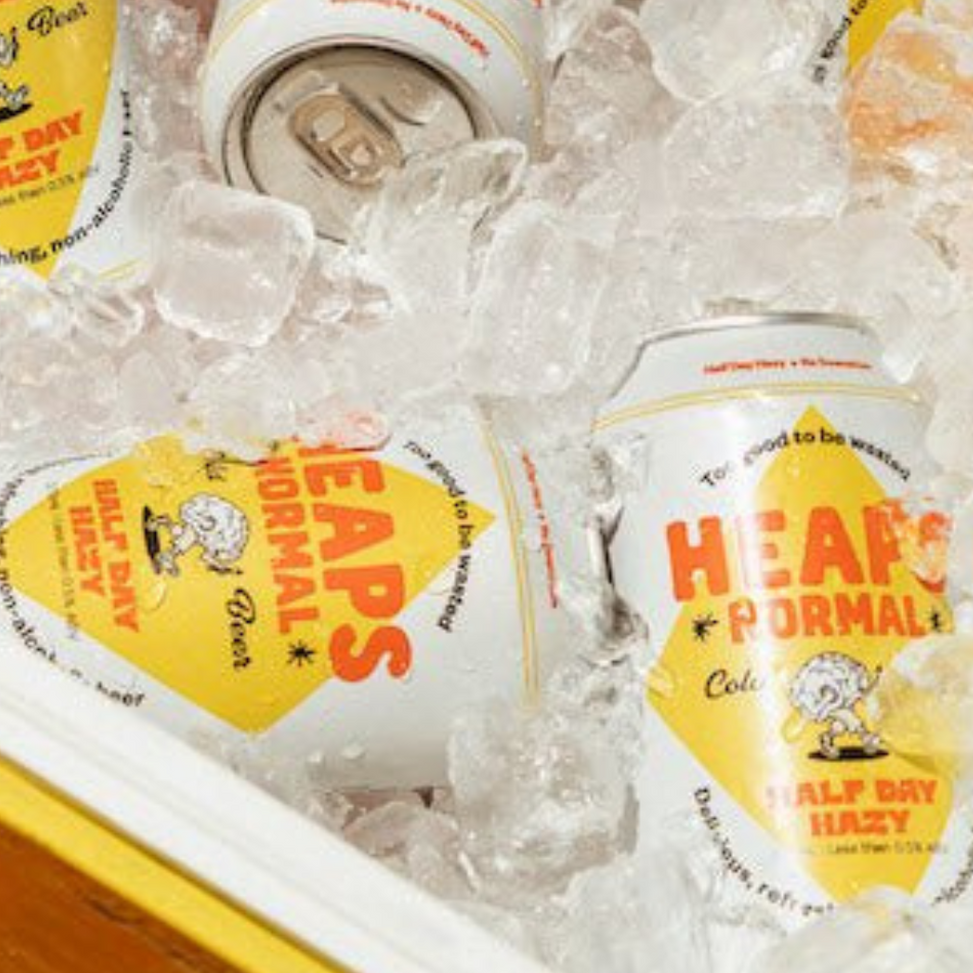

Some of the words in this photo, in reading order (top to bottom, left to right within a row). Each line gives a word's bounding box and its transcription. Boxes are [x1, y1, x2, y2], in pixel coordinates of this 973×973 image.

[27, 2, 88, 36] Beer
[21, 110, 83, 152] DAY
[50, 140, 134, 252] non-alcoholic
[427, 460, 466, 498] good
[700, 460, 733, 487] To
[793, 429, 816, 445] to
[820, 426, 846, 445] be
[850, 436, 911, 482] wasted
[93, 479, 129, 551] HALF
[454, 499, 469, 519] to
[458, 524, 475, 549] be
[69, 506, 106, 597] HAZY
[253, 455, 320, 635] NORMAL
[108, 561, 141, 633] DAY
[437, 554, 471, 633] wasted
[227, 589, 256, 670] Beer
[875, 779, 937, 805] DAY
[810, 810, 911, 836] HAZY
